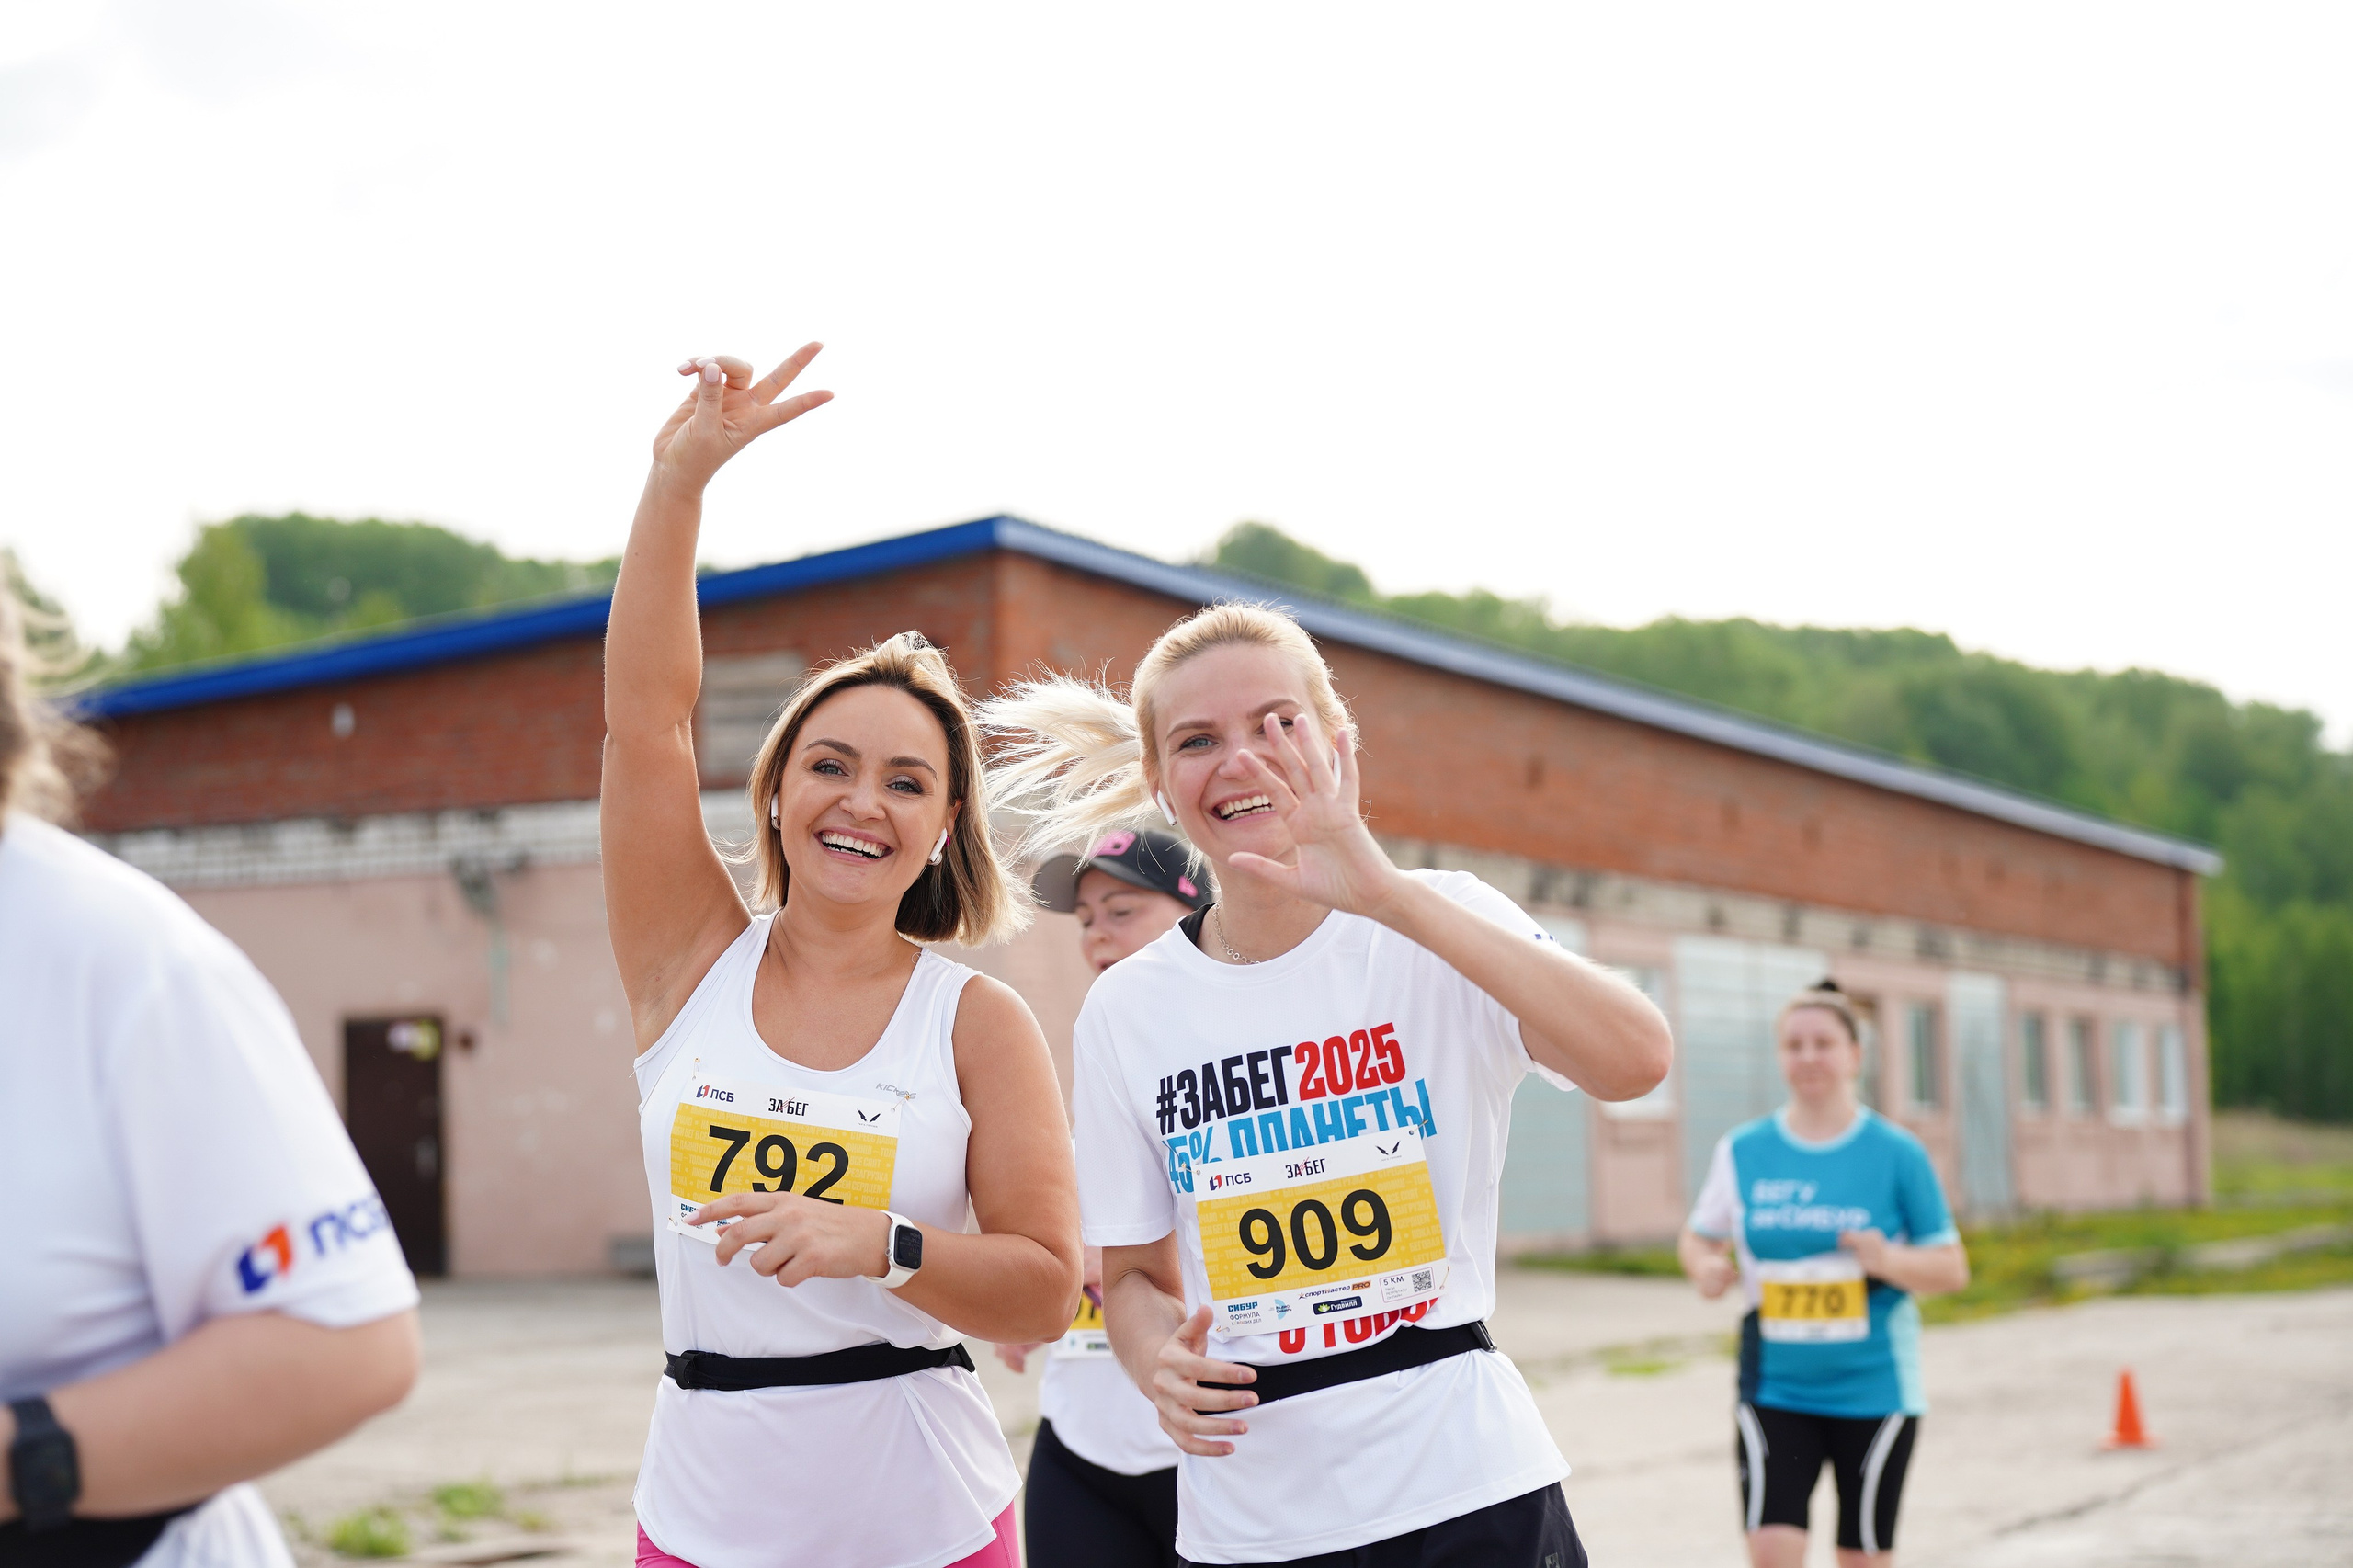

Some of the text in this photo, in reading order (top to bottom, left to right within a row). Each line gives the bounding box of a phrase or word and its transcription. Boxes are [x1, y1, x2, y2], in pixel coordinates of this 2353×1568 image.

[710, 1088, 734, 1103] ПСБ
[709, 1124, 849, 1205] 792
[1225, 1173, 1252, 1186] ПСБ
[1238, 1188, 1392, 1279] 909
[1227, 1301, 1258, 1312] СИБУР
[1776, 1284, 1846, 1316] 770
[1229, 1312, 1261, 1321] ФОРМУЛА
